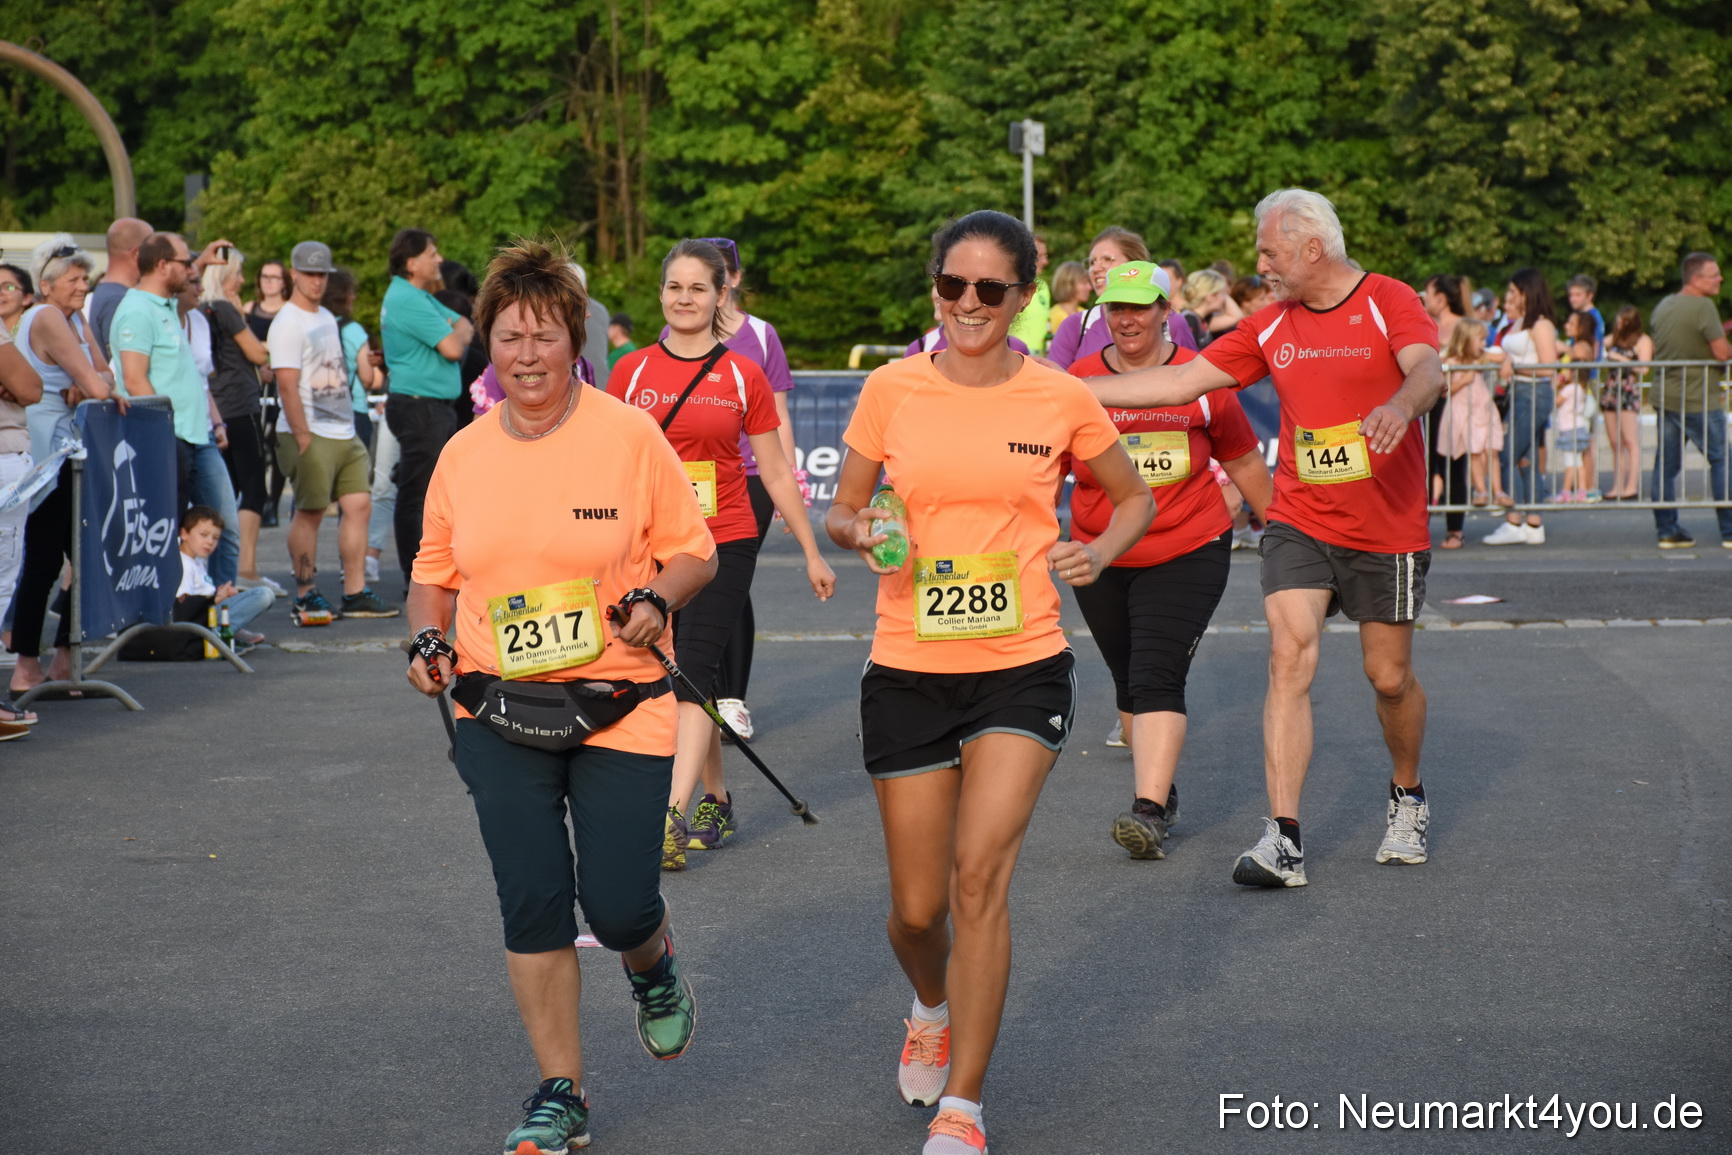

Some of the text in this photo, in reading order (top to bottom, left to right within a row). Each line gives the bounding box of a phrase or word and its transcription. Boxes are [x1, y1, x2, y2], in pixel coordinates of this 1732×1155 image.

[1298, 346, 1371, 360] bfwnürnberg
[662, 393, 738, 411] bfnürnberg
[1113, 410, 1190, 427] bfwnürnberg
[1008, 442, 1052, 458] THULE
[1306, 446, 1350, 469] 144
[1334, 466, 1353, 474] Albert
[572, 508, 618, 520] THULE
[928, 571, 970, 581] firmenlauf
[926, 582, 1008, 616] 2288
[503, 602, 542, 619] firmenlauf
[937, 615, 1001, 626] Collier Mariana
[504, 610, 583, 654] 2317
[510, 641, 589, 663] Van Damme Annick
[512, 721, 573, 738] Kalenji
